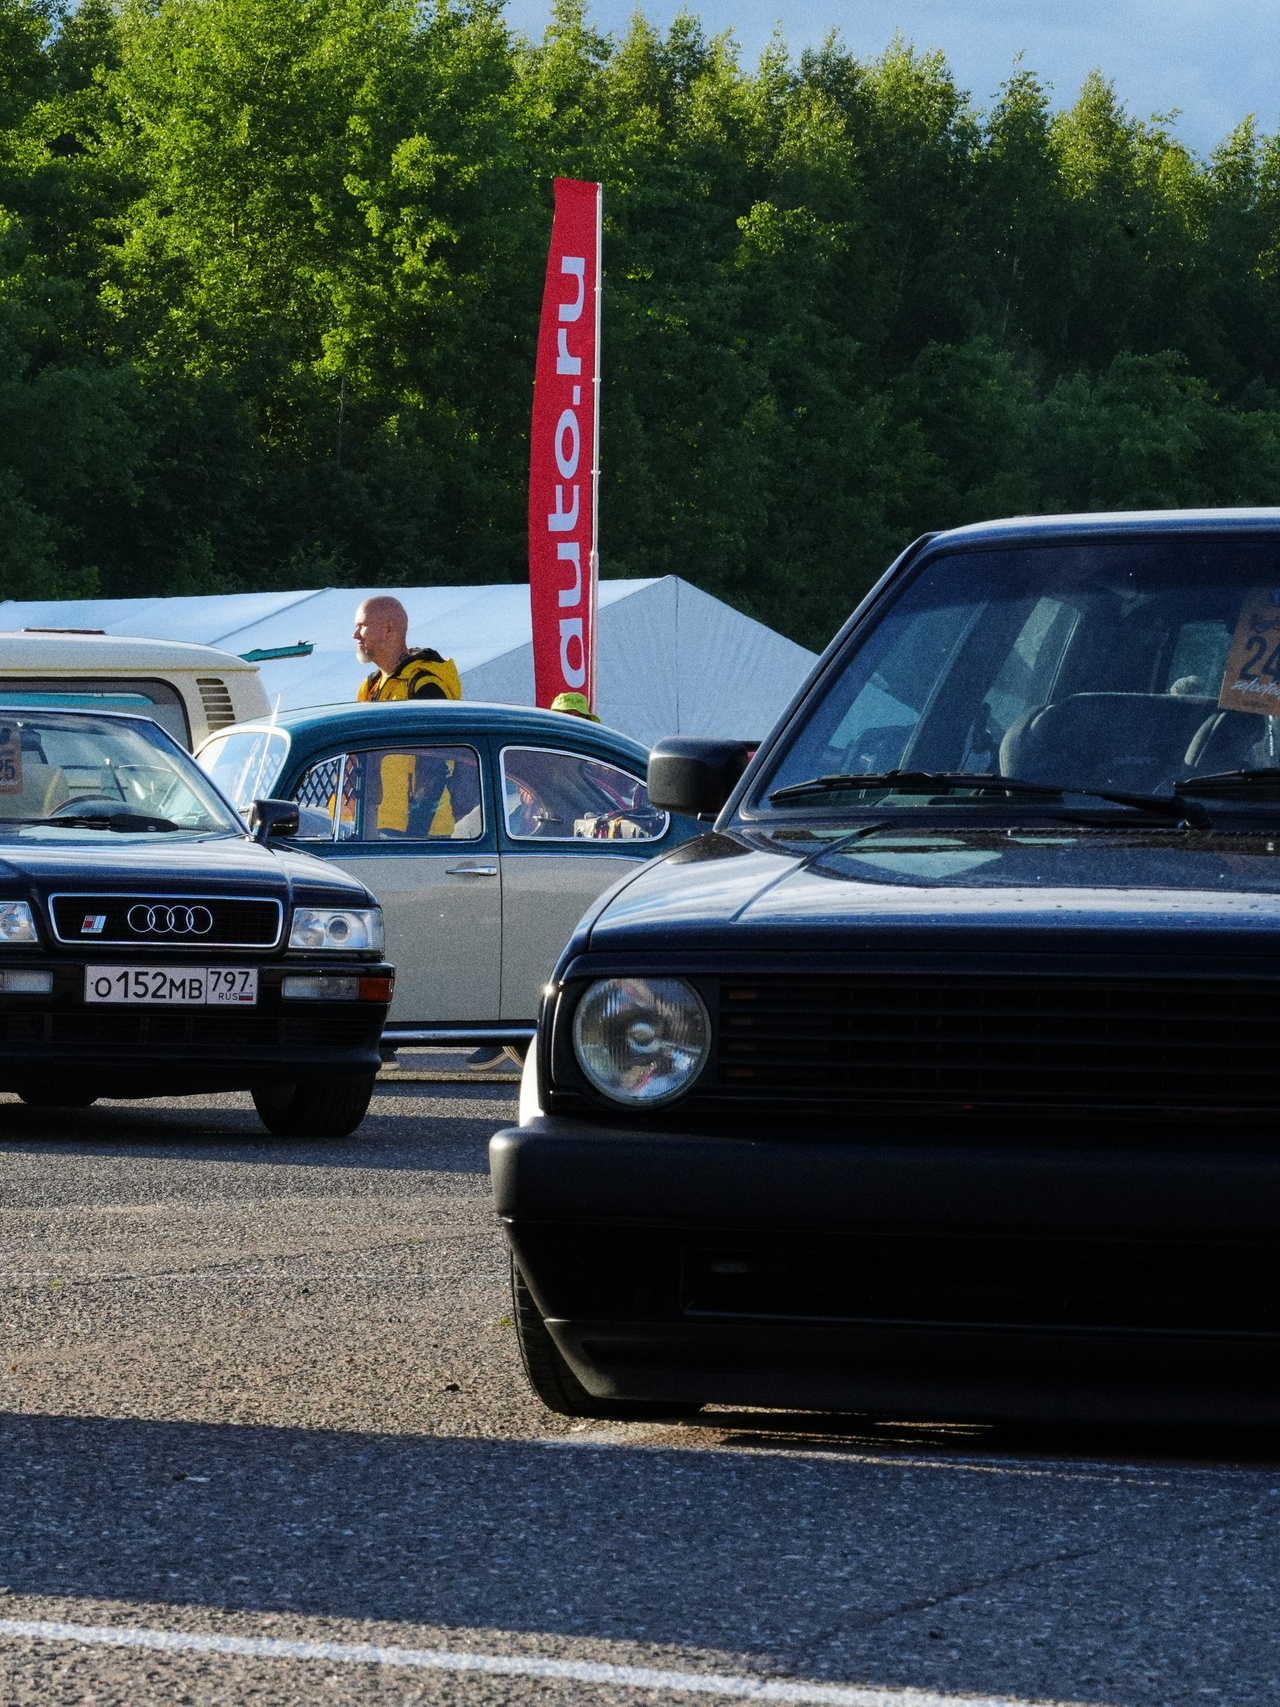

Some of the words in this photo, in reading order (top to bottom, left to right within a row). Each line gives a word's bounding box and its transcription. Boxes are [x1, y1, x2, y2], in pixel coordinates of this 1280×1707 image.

[547, 255, 586, 689] auto.ru
[94, 970, 203, 1000] O152MB
[209, 970, 251, 992] 797
[218, 992, 238, 1001] RUS
